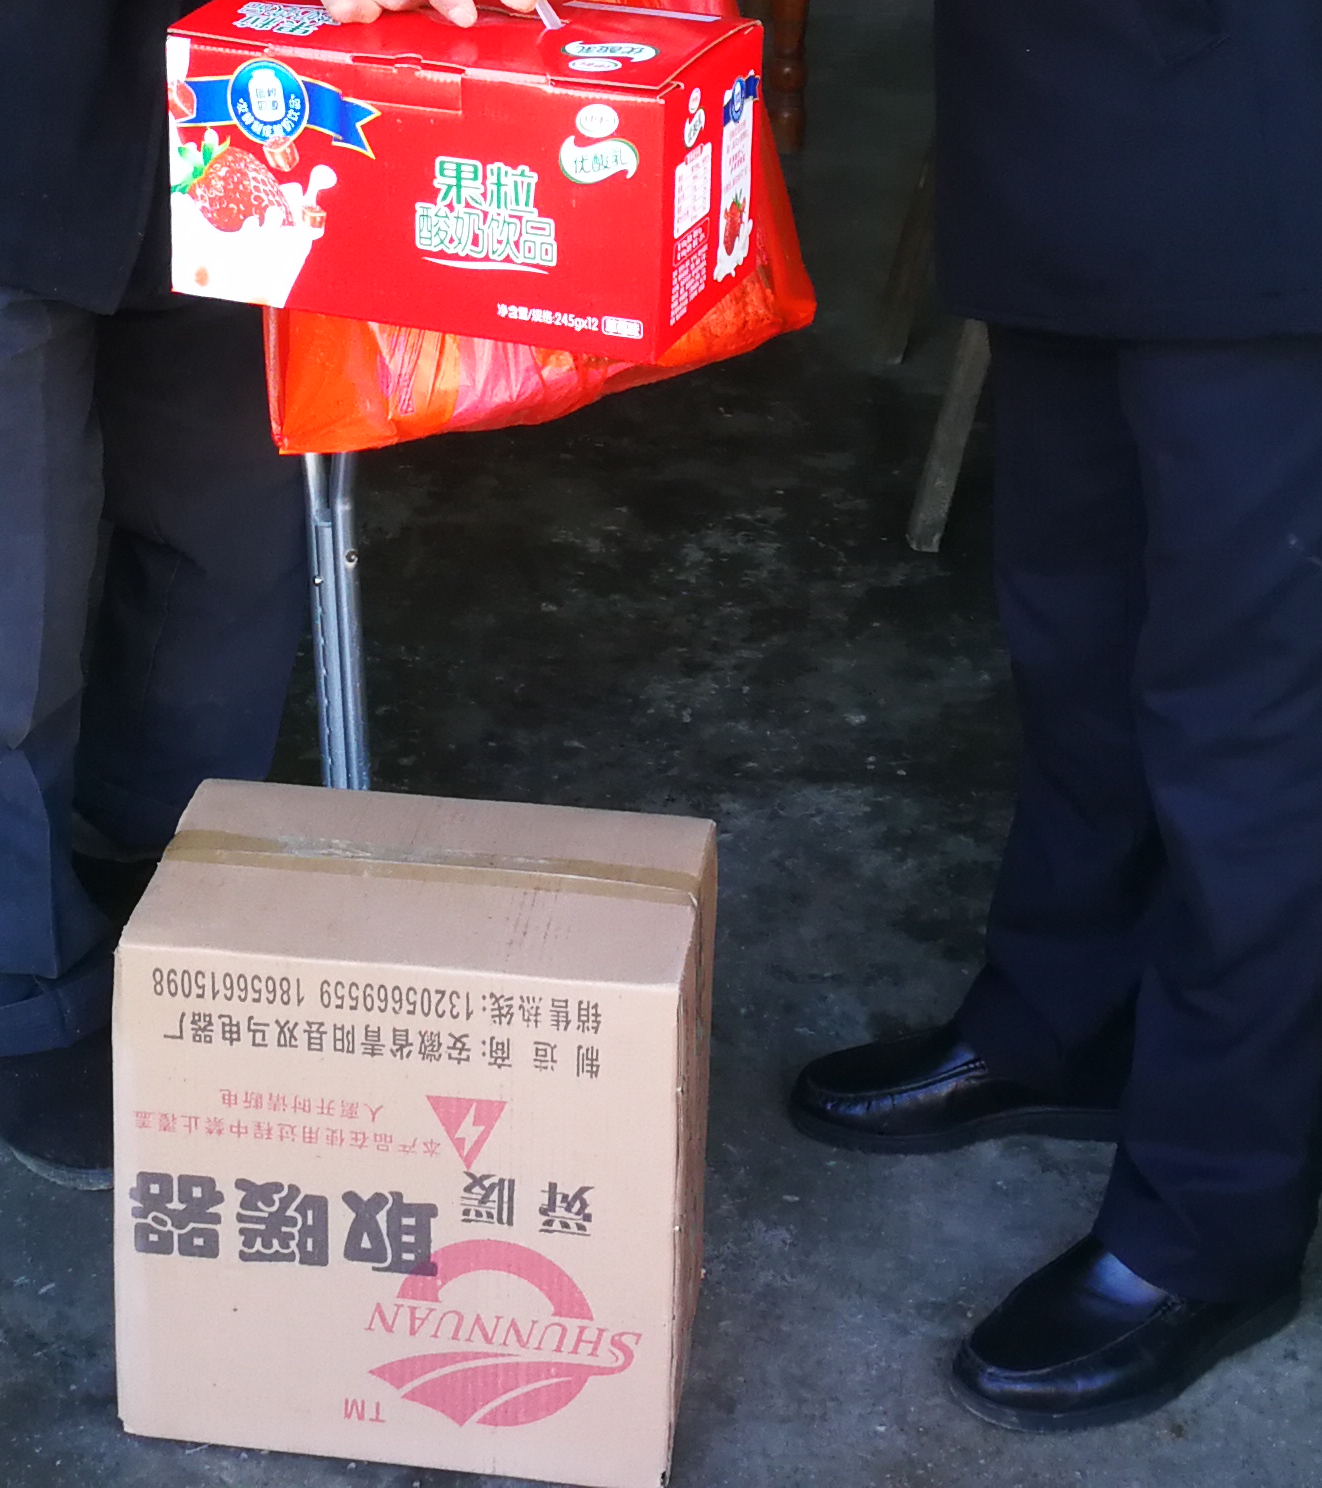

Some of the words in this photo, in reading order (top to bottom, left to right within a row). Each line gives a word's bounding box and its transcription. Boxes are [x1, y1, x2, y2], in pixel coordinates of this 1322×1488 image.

[433, 156, 539, 215] 果粒
[573, 148, 628, 174] 优酸乳
[414, 204, 557, 268] 酸奶饮品
[152, 966, 305, 1008] 18656615098
[218, 1088, 385, 1123] 人离开时请断电
[133, 1109, 443, 1158] 本产品在使用过程中禁止覆盖
[129, 1170, 440, 1278] 取暖器
[364, 1301, 643, 1368] SHUNNUAN
[343, 1398, 387, 1424] TM
